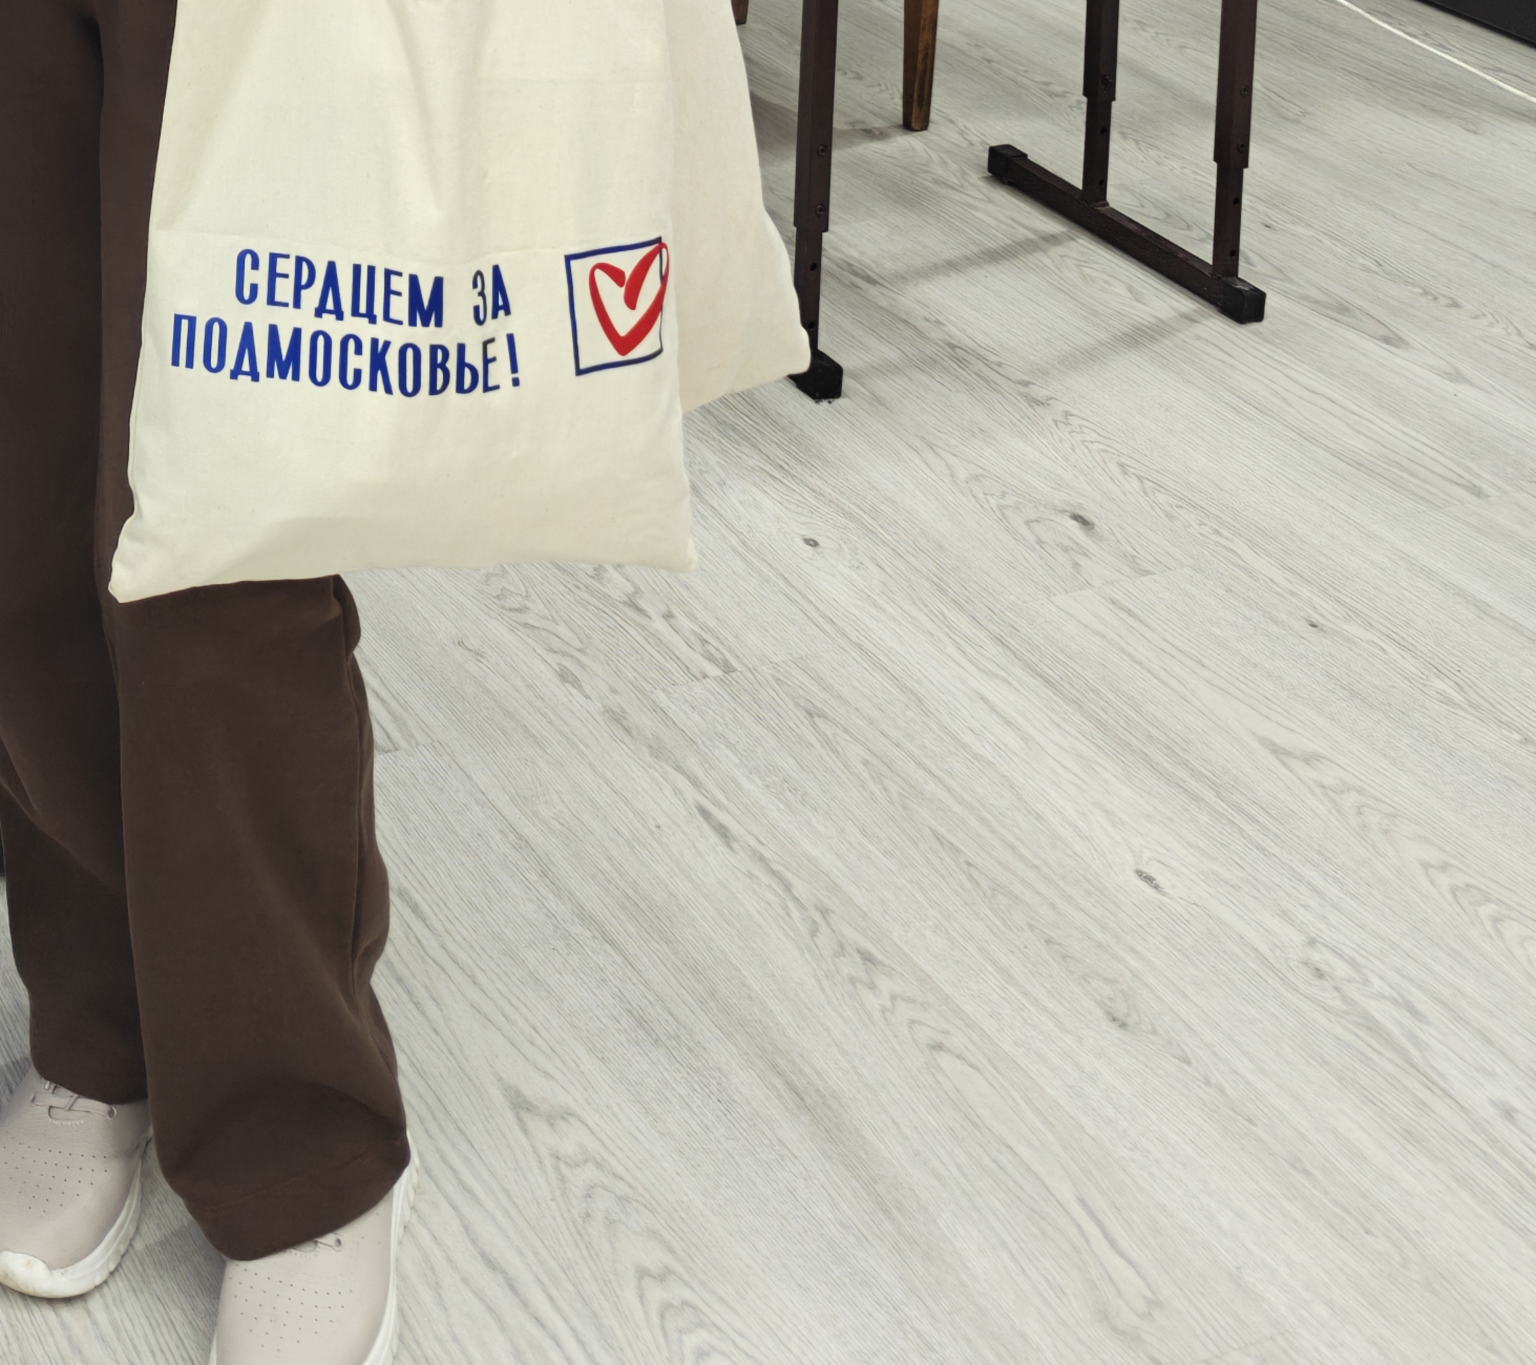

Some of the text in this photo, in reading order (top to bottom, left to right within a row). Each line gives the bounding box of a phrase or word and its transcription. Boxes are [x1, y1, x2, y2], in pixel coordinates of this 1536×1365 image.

[234, 248, 513, 328] СЕРДЦЕМ ЗА
[171, 313, 522, 398] ПОДМОСКОВЬЕ!
